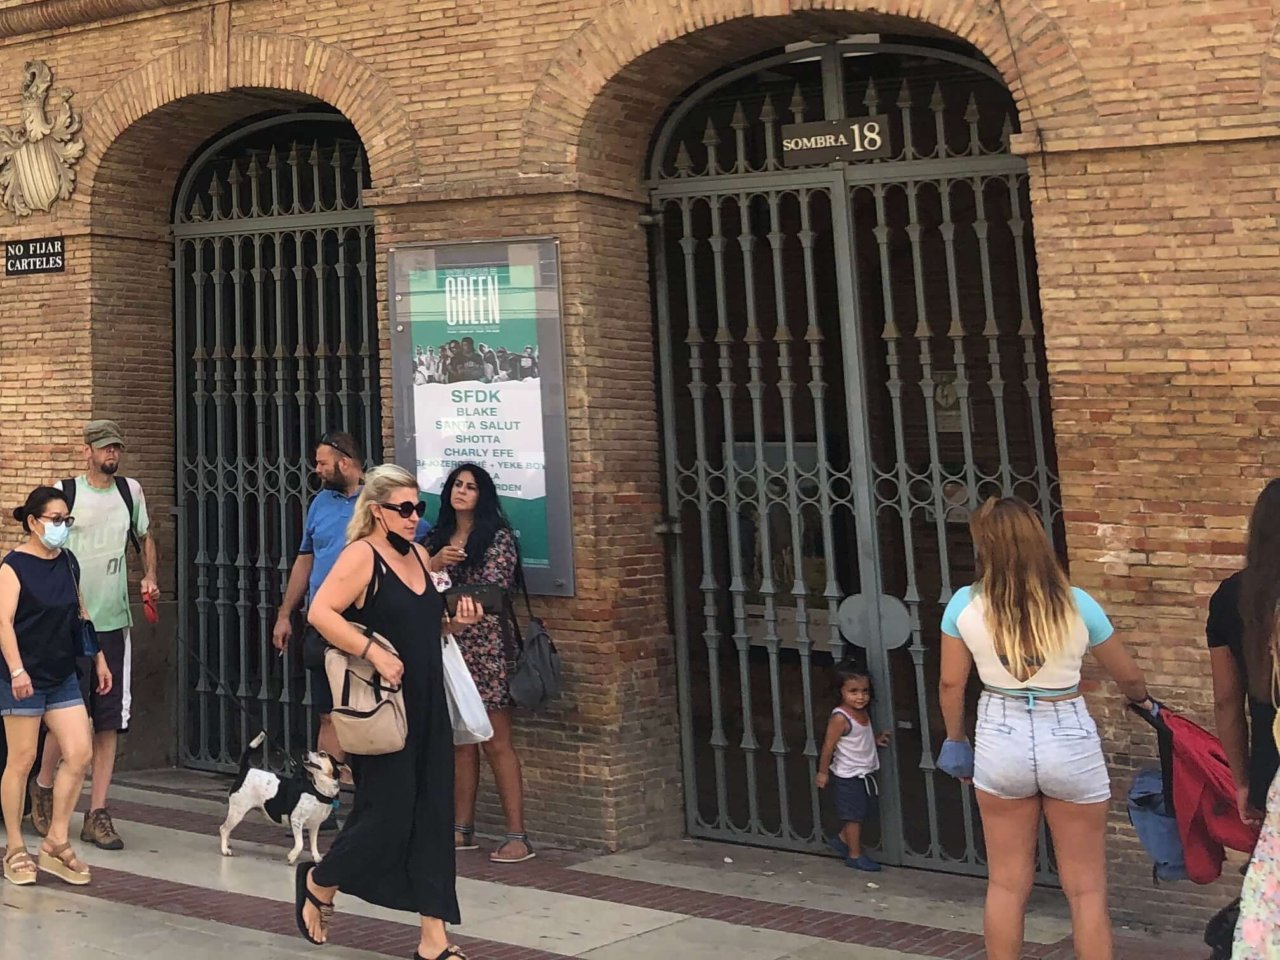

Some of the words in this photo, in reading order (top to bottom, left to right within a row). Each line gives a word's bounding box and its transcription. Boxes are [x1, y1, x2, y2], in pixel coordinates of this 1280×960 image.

[782, 134, 849, 151] SOMBRA
[850, 121, 882, 152] 18
[7, 243, 24, 257] NO
[29, 241, 62, 255] FIJAR
[7, 256, 62, 271] CARTELES
[445, 275, 500, 325] GREEN
[451, 390, 501, 403] SFDK
[456, 407, 498, 417] BLAKE
[435, 421, 476, 431] SANTA
[480, 421, 521, 431] SALUT
[455, 434, 501, 444] SHOTTA
[444, 448, 489, 457] CHARLY
[492, 449, 514, 458] EFE
[499, 461, 524, 470] YEKE
